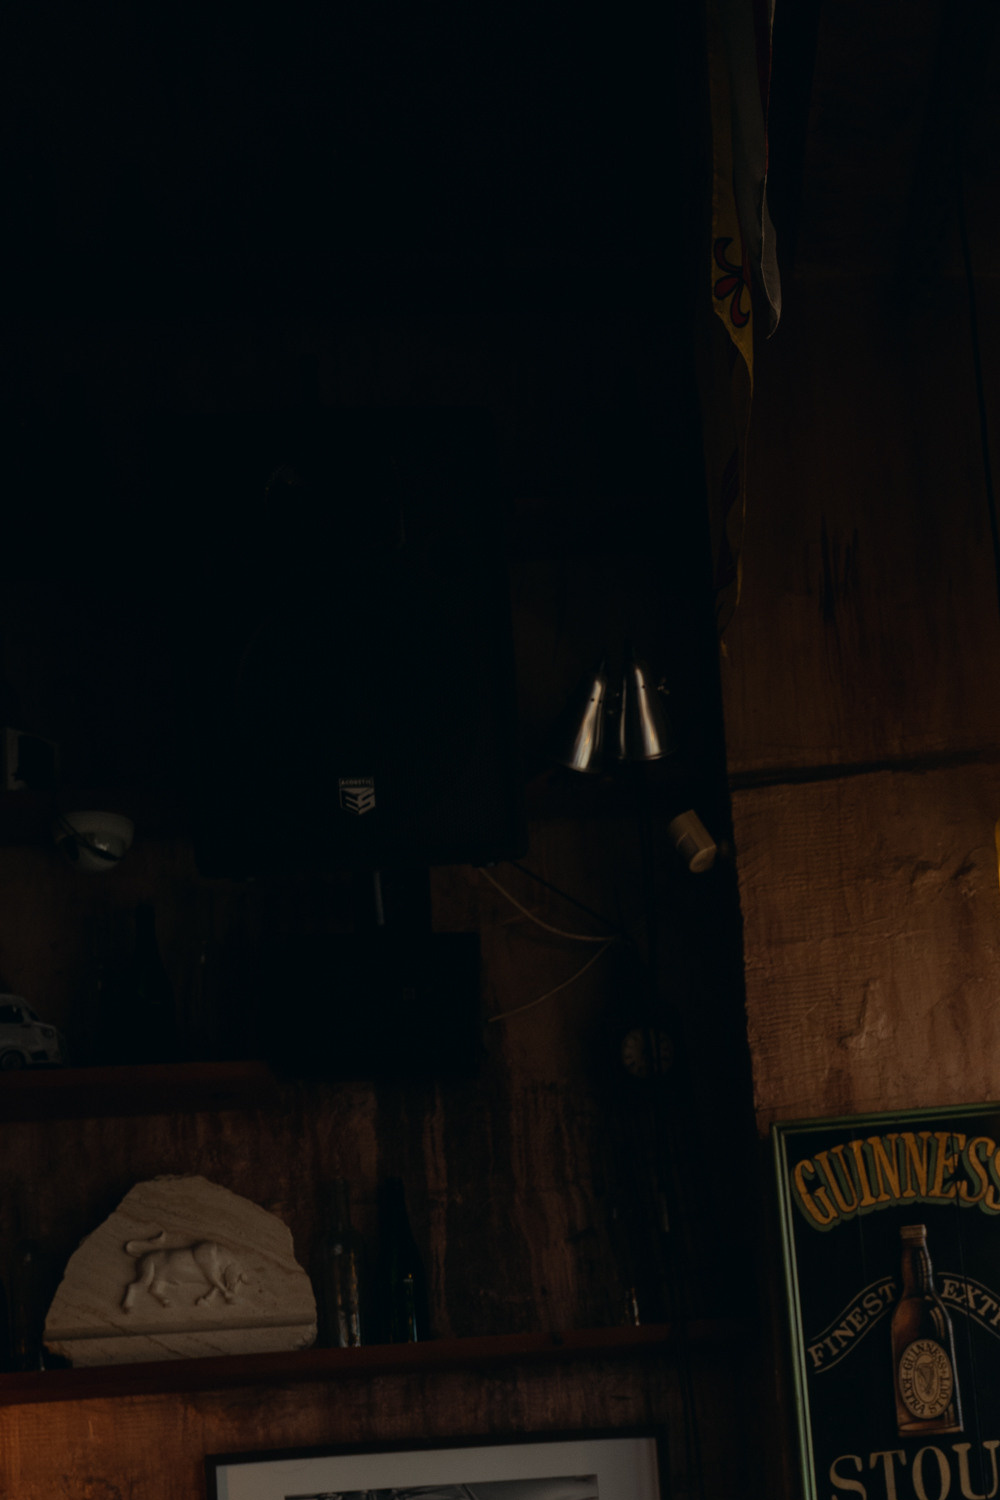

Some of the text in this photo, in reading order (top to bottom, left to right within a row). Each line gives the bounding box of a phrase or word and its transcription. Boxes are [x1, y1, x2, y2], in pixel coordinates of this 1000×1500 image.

[807, 1282, 896, 1367] FINEST
[903, 1342, 947, 1370] GUINNESS
[902, 1377, 950, 1414] EXTRA STOUT
